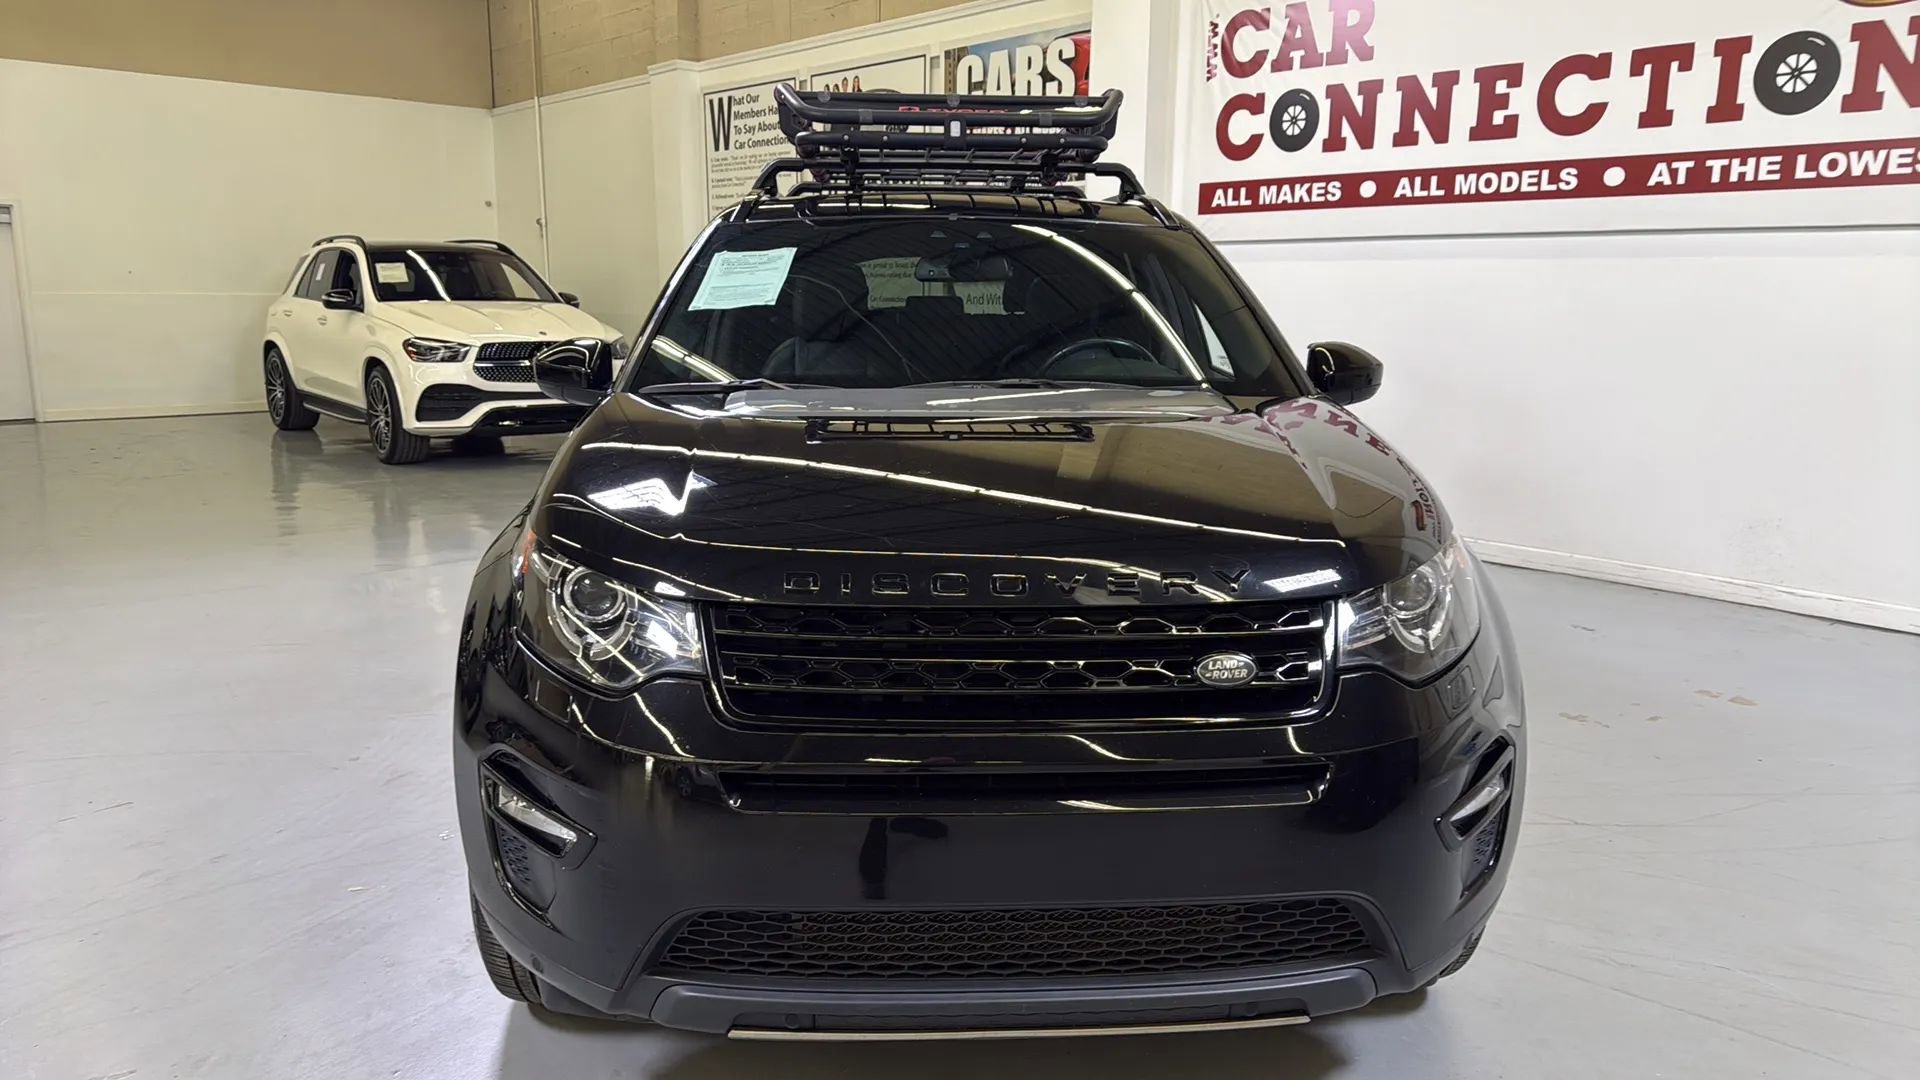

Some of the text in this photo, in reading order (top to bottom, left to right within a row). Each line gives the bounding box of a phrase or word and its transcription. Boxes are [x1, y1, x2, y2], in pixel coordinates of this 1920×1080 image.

[1221, 0, 1374, 78] CAR
[956, 38, 1076, 97] CARS
[1216, 15, 1920, 161] CONNECTION
[746, 93, 760, 104] Our
[734, 105, 779, 120] Members Ha
[734, 125, 742, 135] To
[743, 124, 756, 136] Say
[734, 134, 790, 150] Car Connection
[1212, 148, 1920, 207] ALL MAKES ALL MODELS AT THE LOWE
[966, 292, 985, 306] And
[783, 569, 1250, 597] DISCOVERY
[1208, 660, 1238, 670] LAND
[1212, 669, 1248, 680] ROVER
